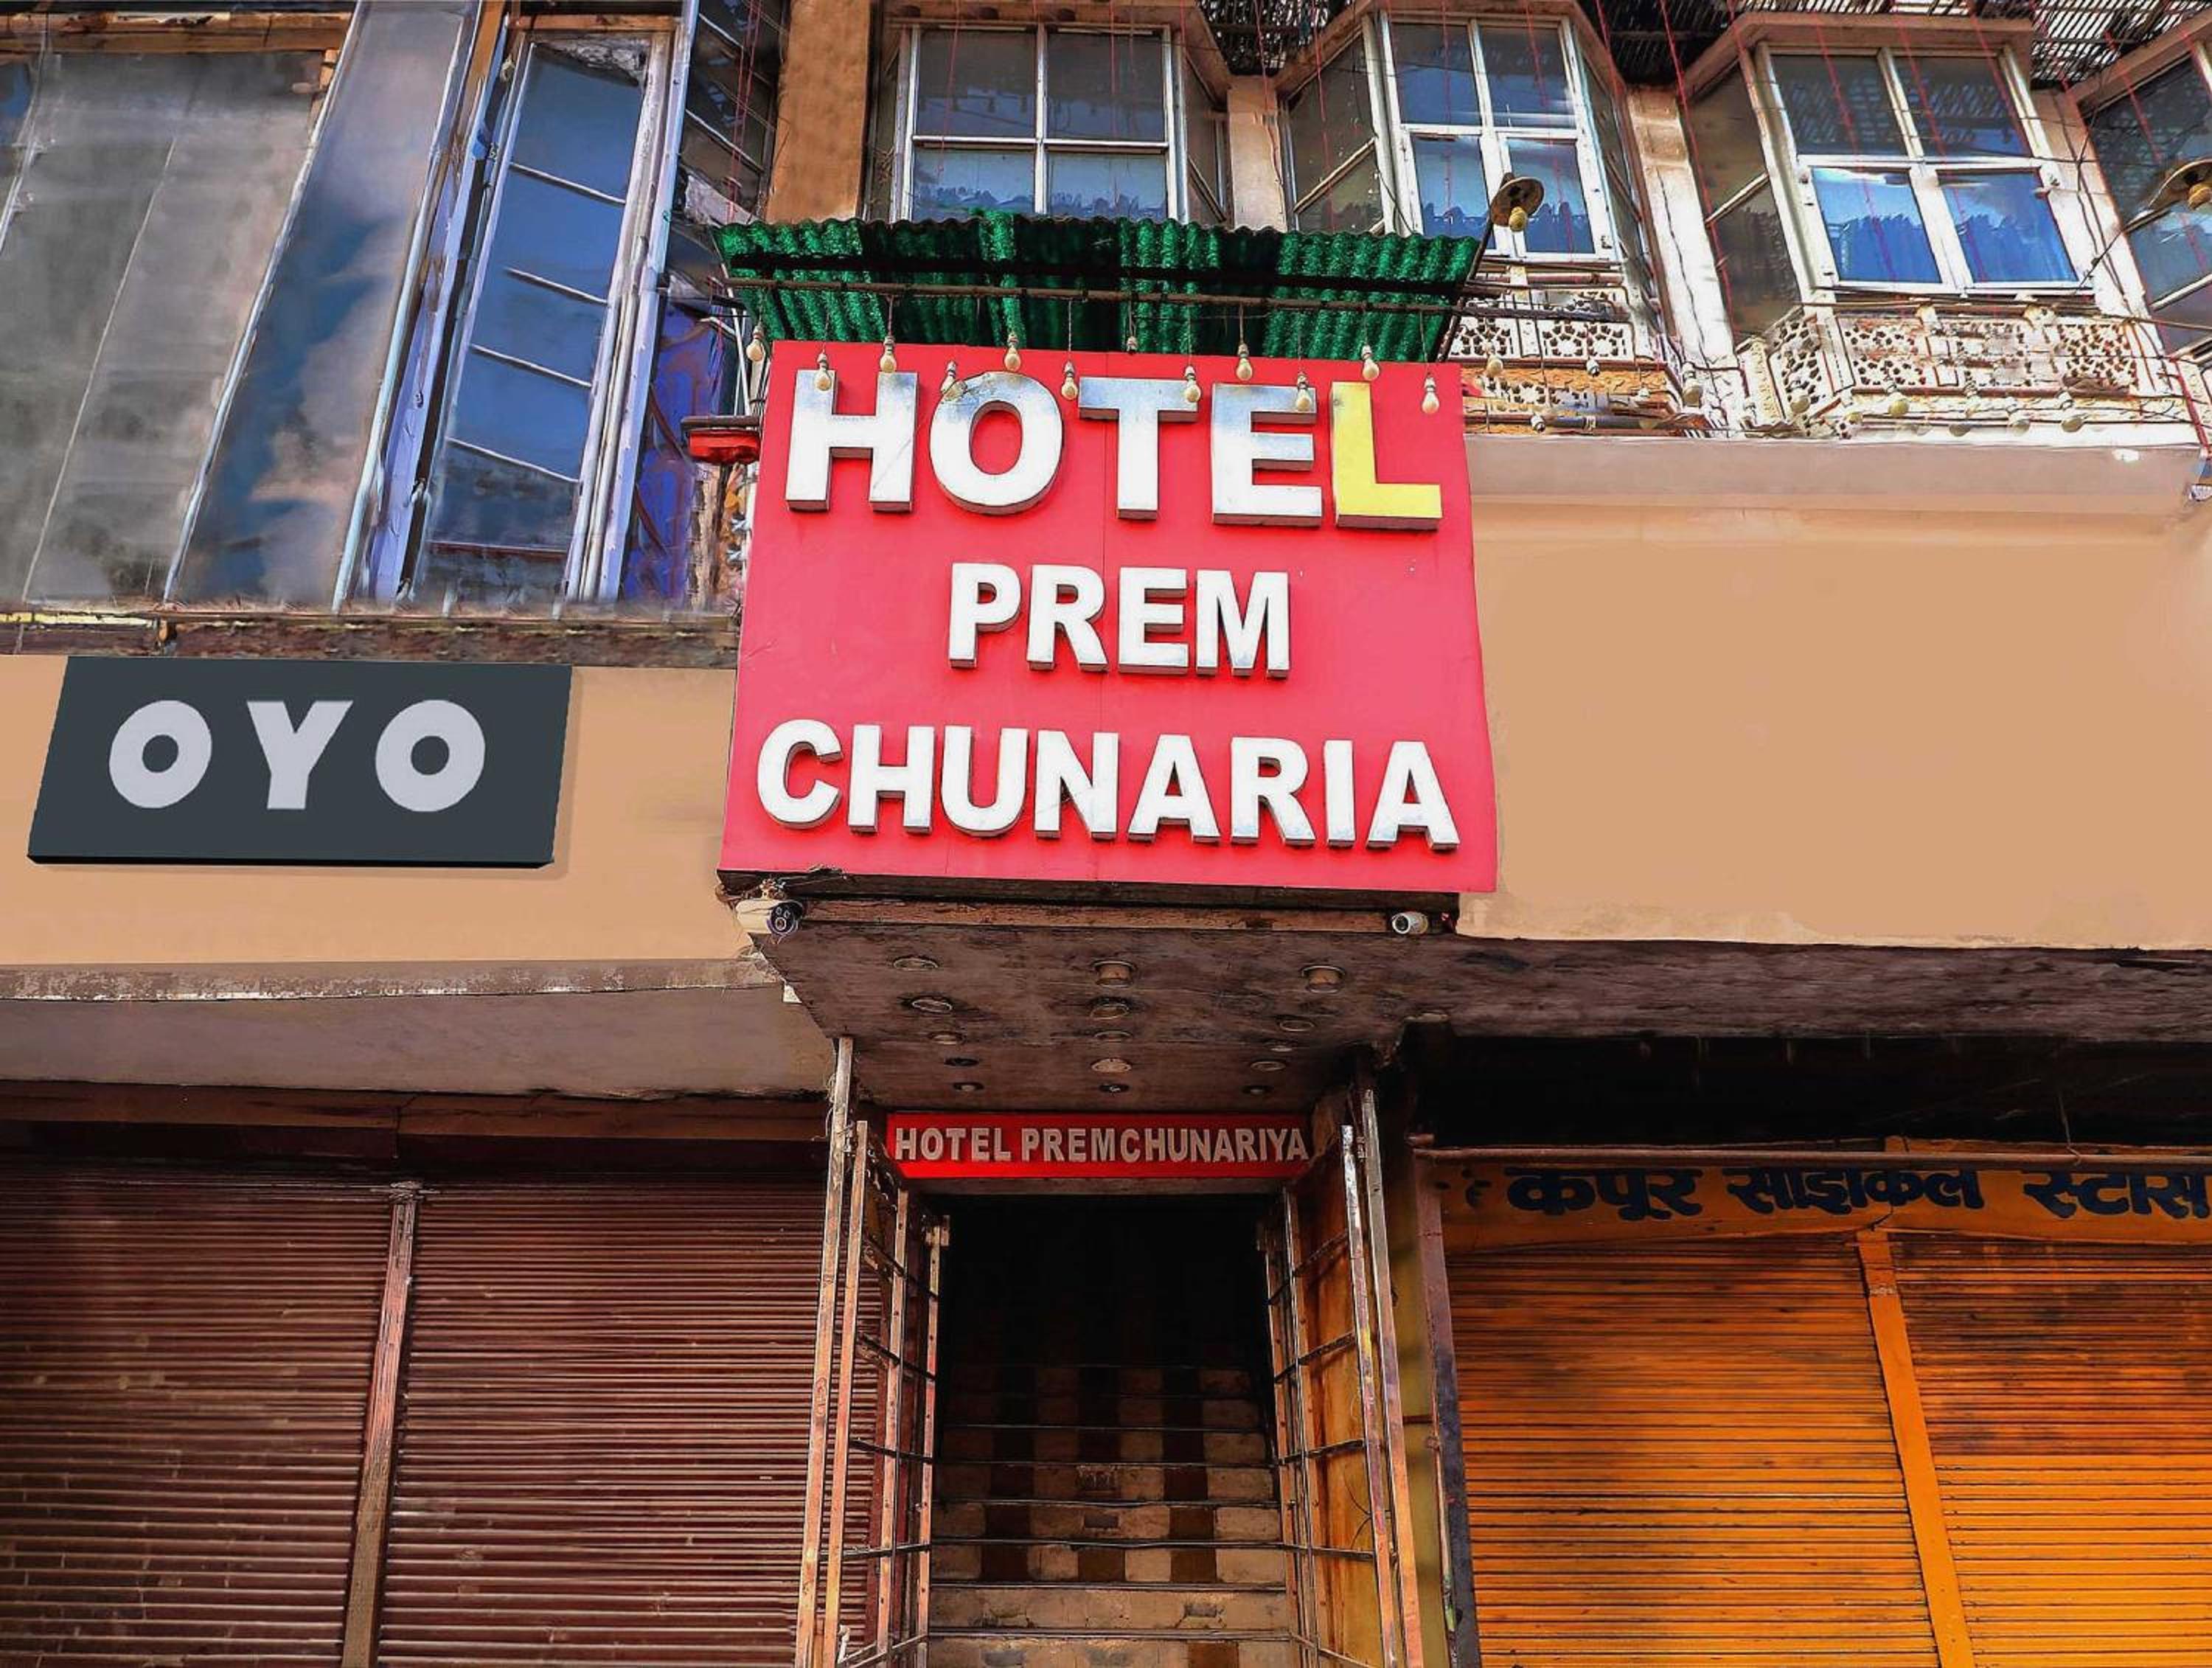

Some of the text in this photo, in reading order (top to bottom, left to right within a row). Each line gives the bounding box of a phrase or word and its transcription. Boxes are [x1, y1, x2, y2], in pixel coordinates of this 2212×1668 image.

[786, 369, 1441, 530] HOTEL
[948, 563, 1290, 679] PREM
[108, 699, 486, 813] OYO
[757, 719, 1460, 850] CHUNARIA
[894, 1127, 1011, 1161] HOTEL
